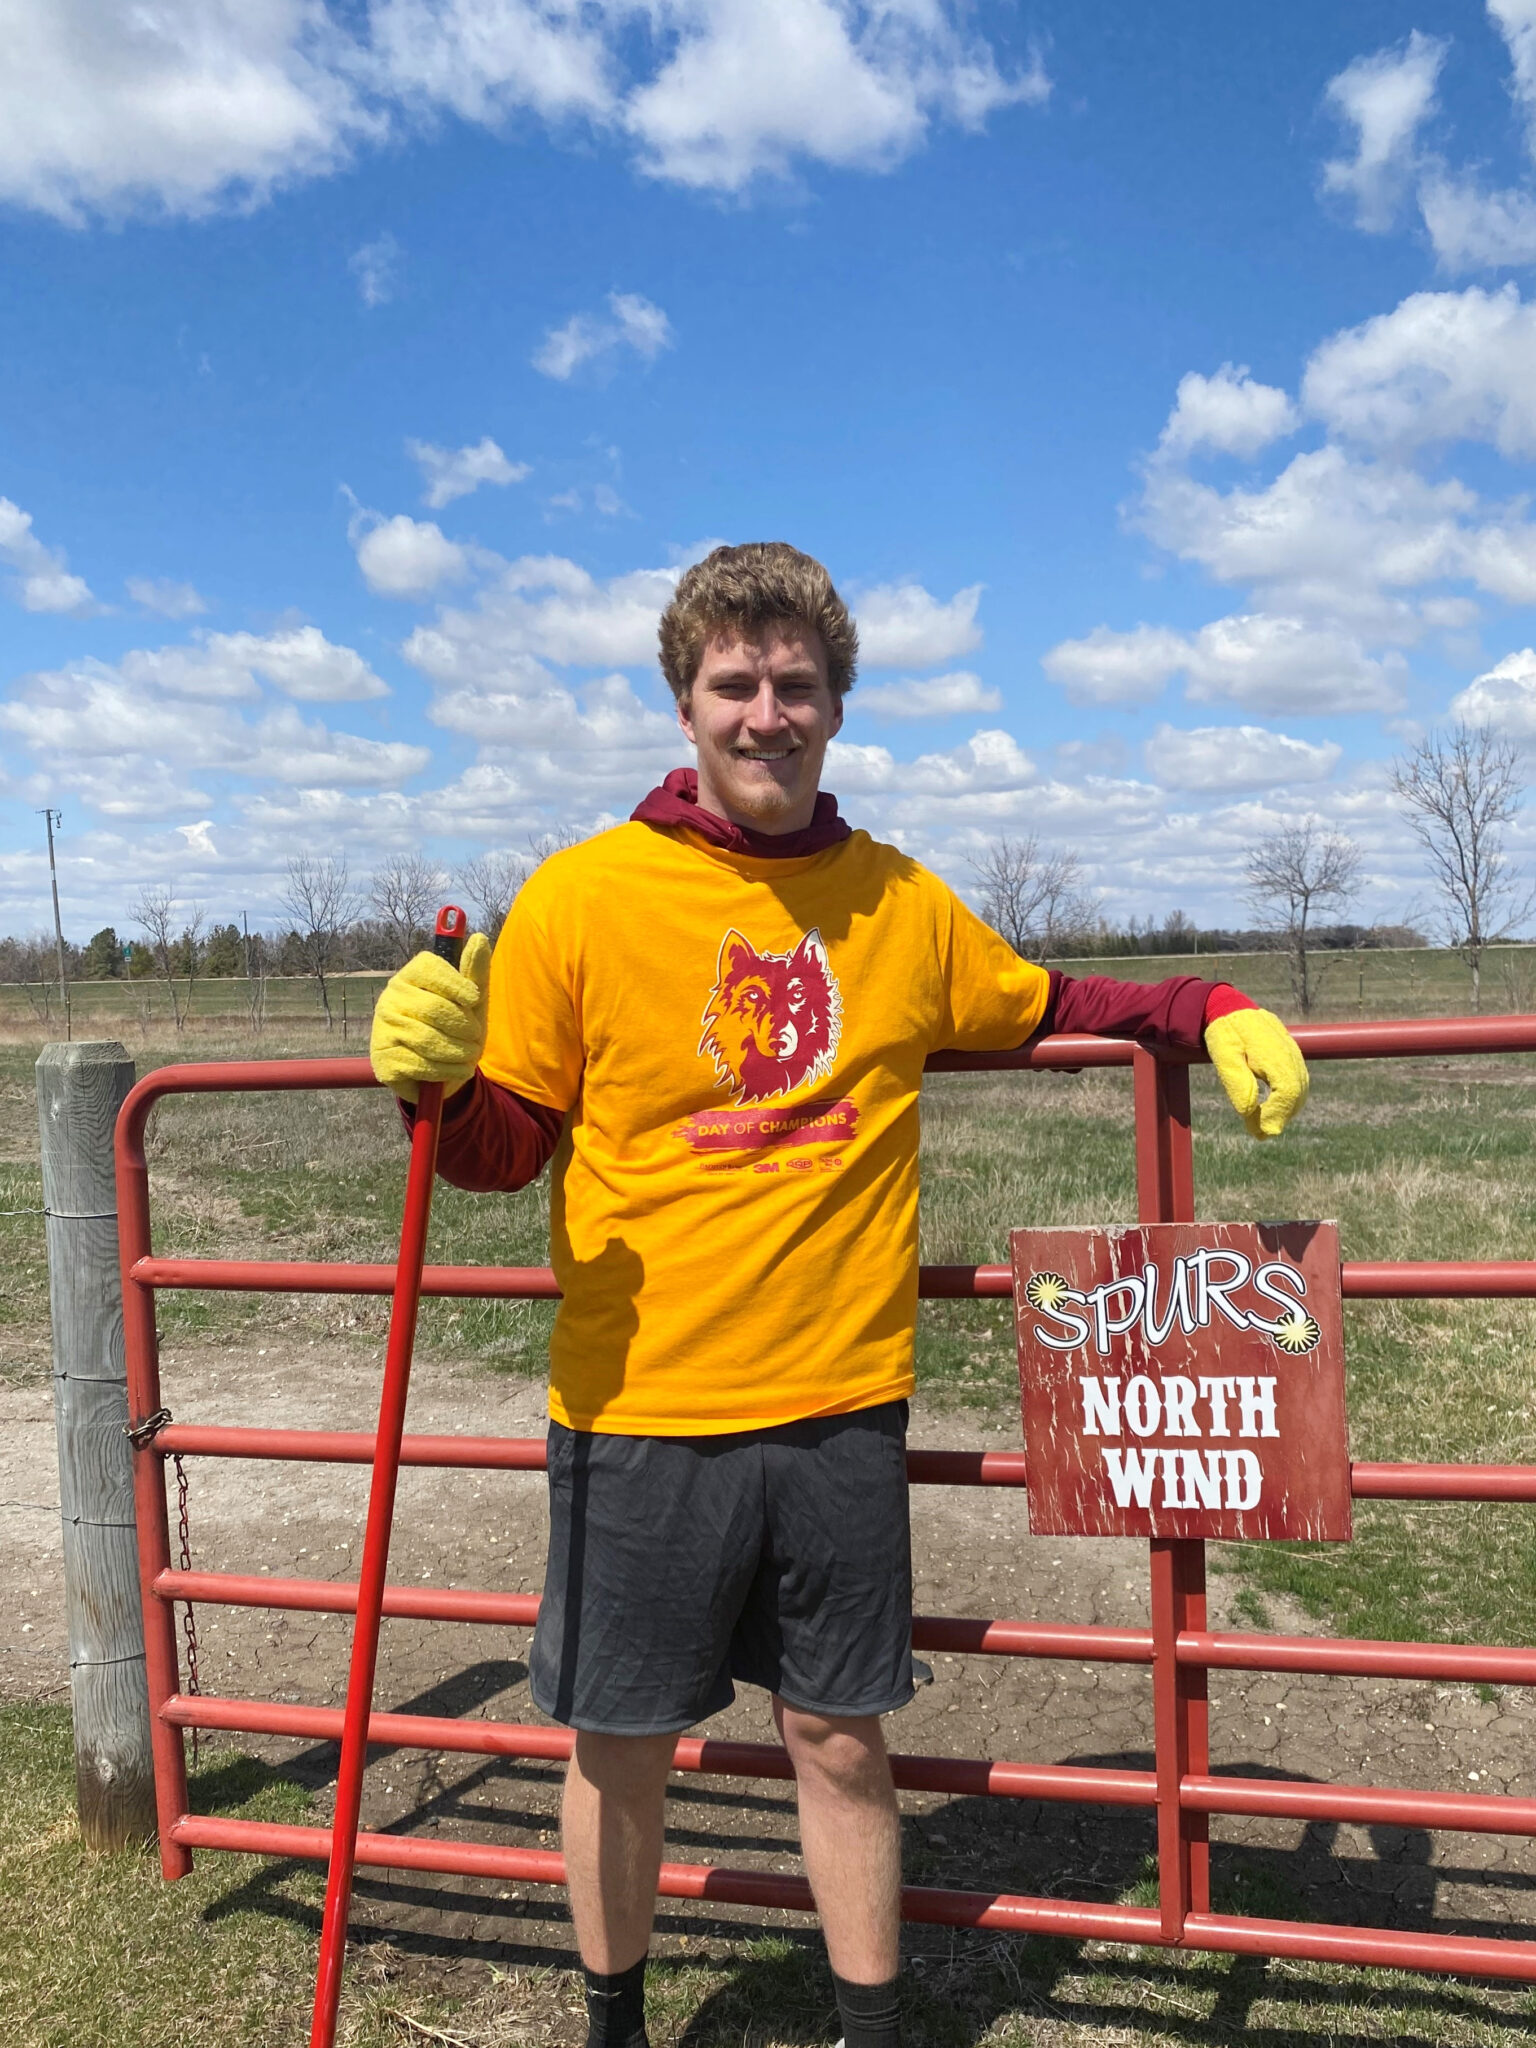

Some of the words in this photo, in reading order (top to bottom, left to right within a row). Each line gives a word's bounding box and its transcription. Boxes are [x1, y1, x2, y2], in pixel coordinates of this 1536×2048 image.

[698, 1123, 729, 1136] DAY
[734, 1121, 754, 1134] OF
[759, 1112, 846, 1133] CHAMPIONS
[753, 1162, 780, 1174] 3M
[1026, 1247, 1321, 1356] SPURS
[1079, 1375, 1281, 1438] NORTH
[1101, 1448, 1264, 1511] WIND
